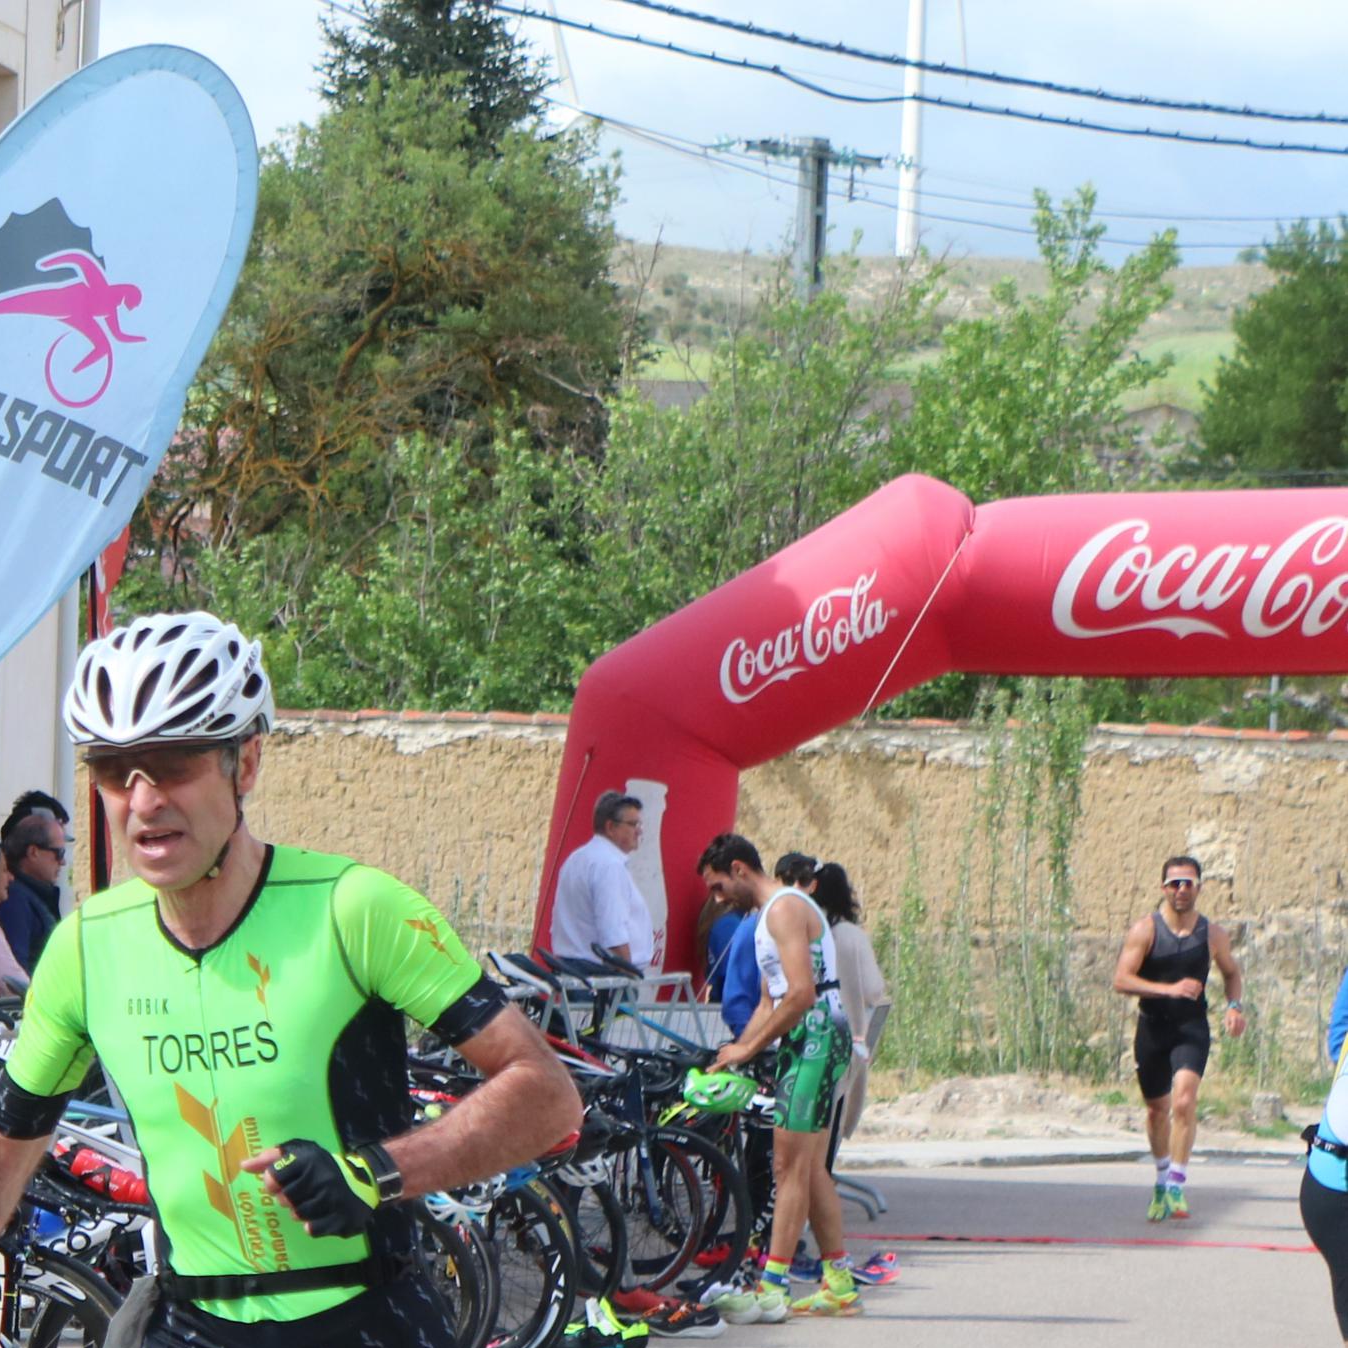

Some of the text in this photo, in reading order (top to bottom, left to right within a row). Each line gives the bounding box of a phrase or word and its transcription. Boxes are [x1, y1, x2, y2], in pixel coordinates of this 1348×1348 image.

[719, 569, 889, 704] Coca-Cola
[127, 998, 169, 1016] GOBIK
[142, 1020, 279, 1076] TORRES
